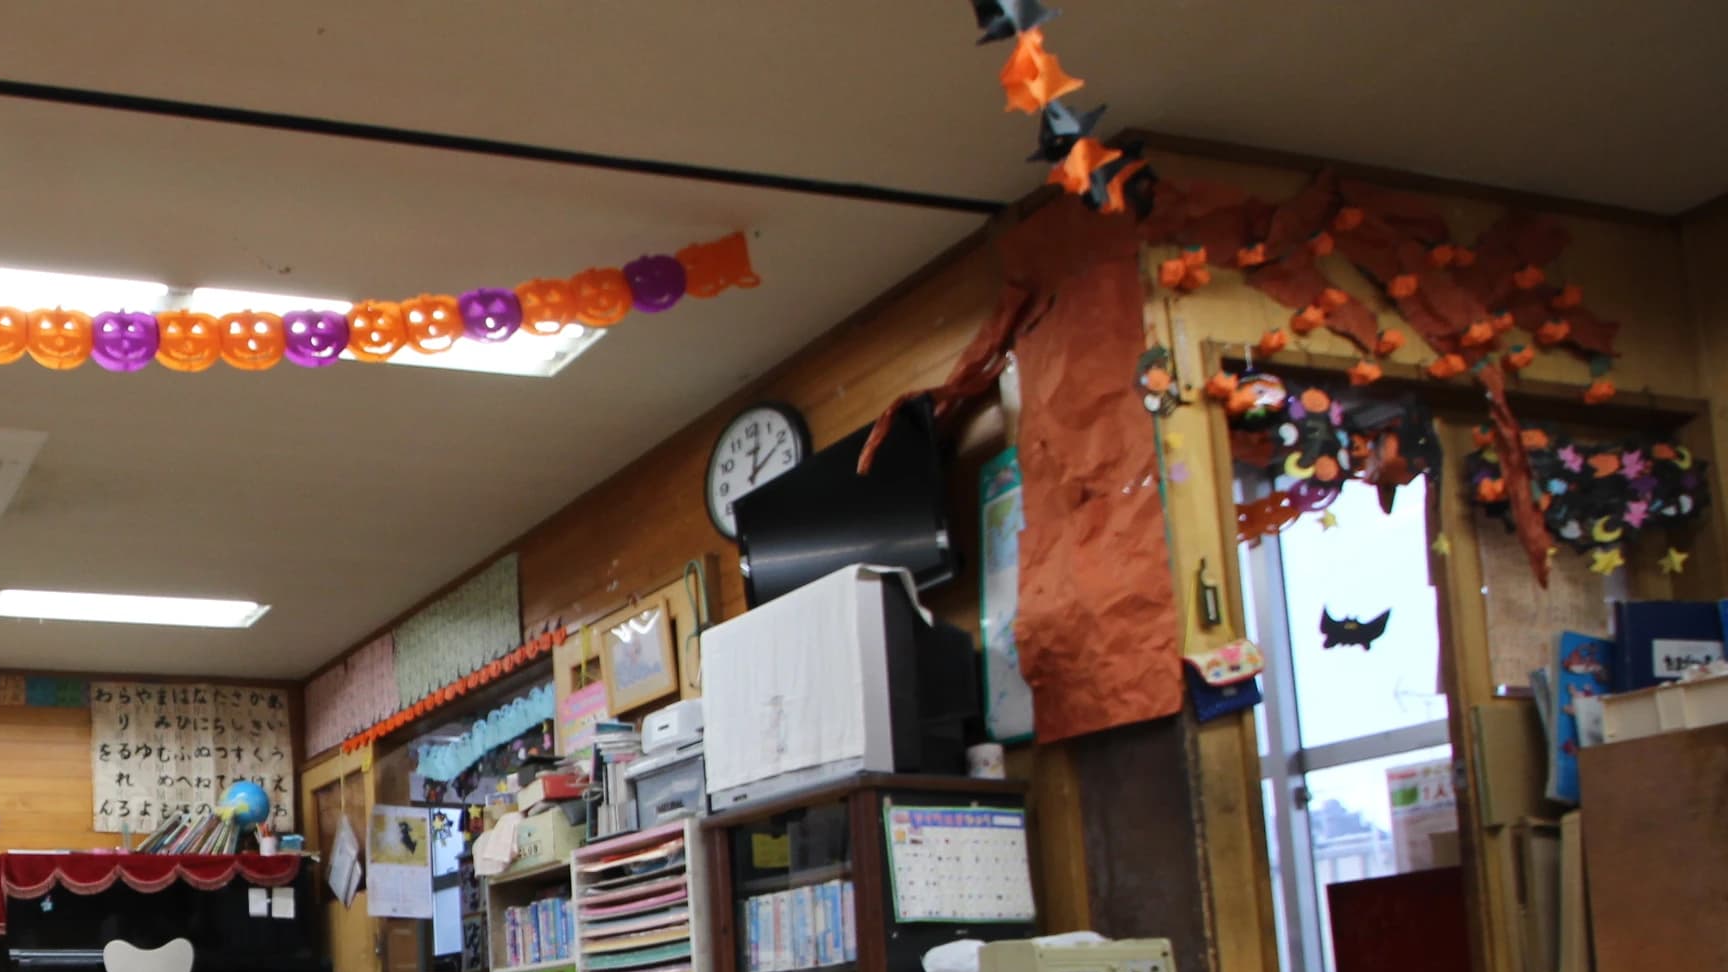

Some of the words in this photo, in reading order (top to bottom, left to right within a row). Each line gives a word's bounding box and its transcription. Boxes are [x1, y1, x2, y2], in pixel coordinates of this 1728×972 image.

[766, 421, 771, 434] 1
[776, 429, 786, 445] 2
[731, 438, 742, 454] 11
[783, 449, 792, 465] 3
[721, 459, 734, 475] 10
[720, 482, 730, 496] 9
